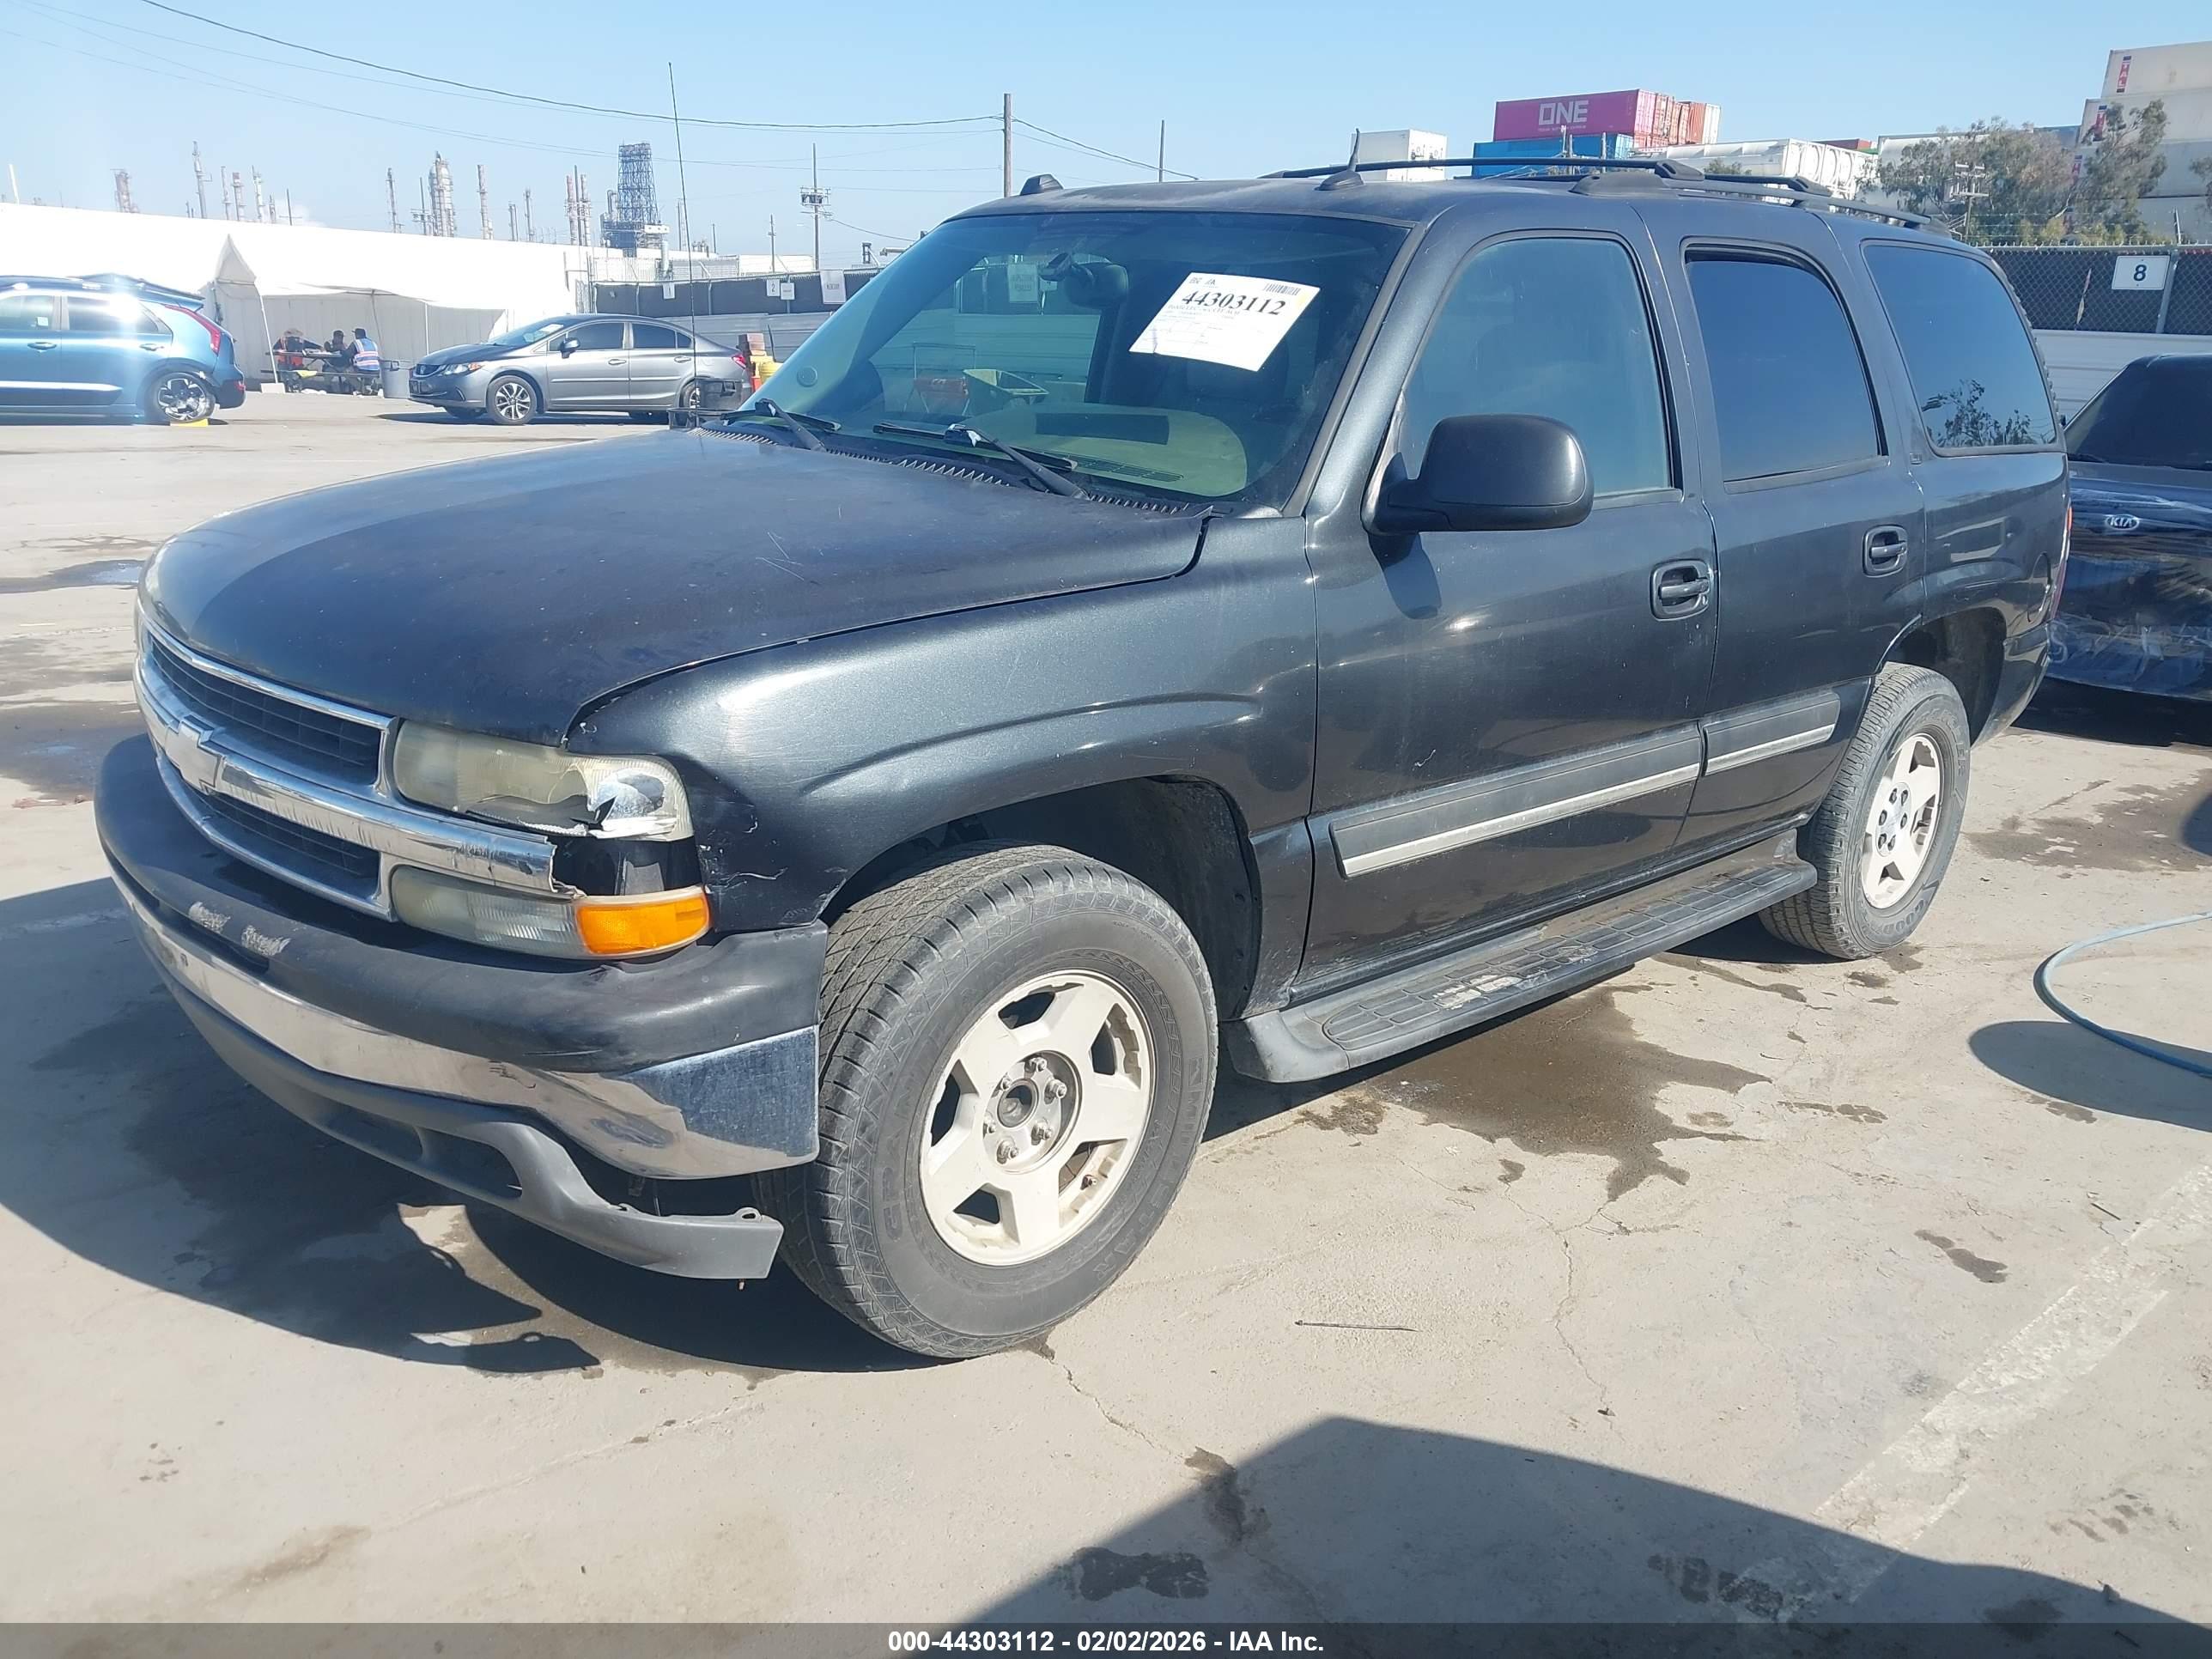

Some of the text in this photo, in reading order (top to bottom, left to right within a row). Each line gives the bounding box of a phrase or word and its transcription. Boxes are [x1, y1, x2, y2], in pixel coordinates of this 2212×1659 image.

[1538, 100, 1589, 125] ONE
[2133, 264, 2147, 282] 8
[1182, 290, 1286, 316] 44303112
[2110, 517, 2133, 527] KIA
